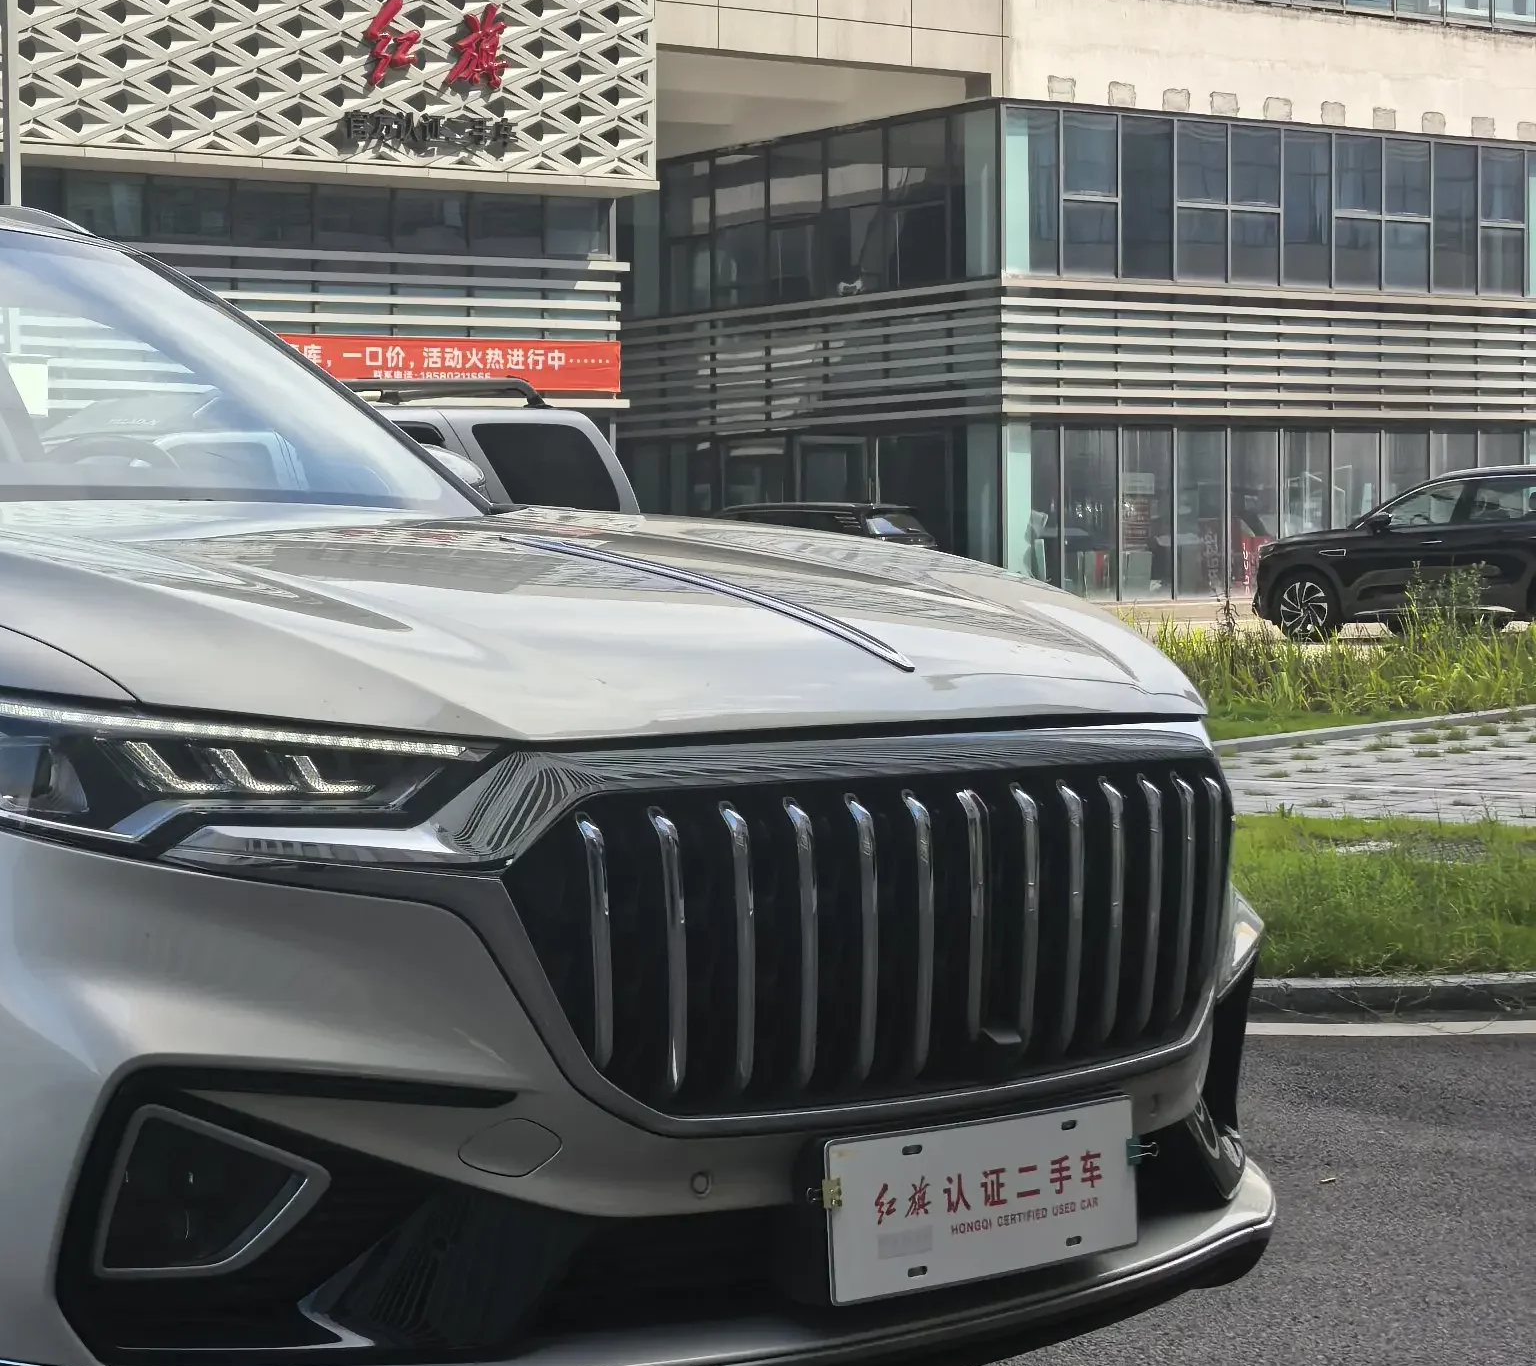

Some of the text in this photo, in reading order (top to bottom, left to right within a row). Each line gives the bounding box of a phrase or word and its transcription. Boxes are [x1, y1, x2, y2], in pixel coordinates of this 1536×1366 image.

[344, 110, 519, 147] 官方认证二手车
[874, 1149, 1103, 1225] 红旗认证二手车
[951, 1196, 1099, 1235] HONGQI CERTIFIED USED CAR
